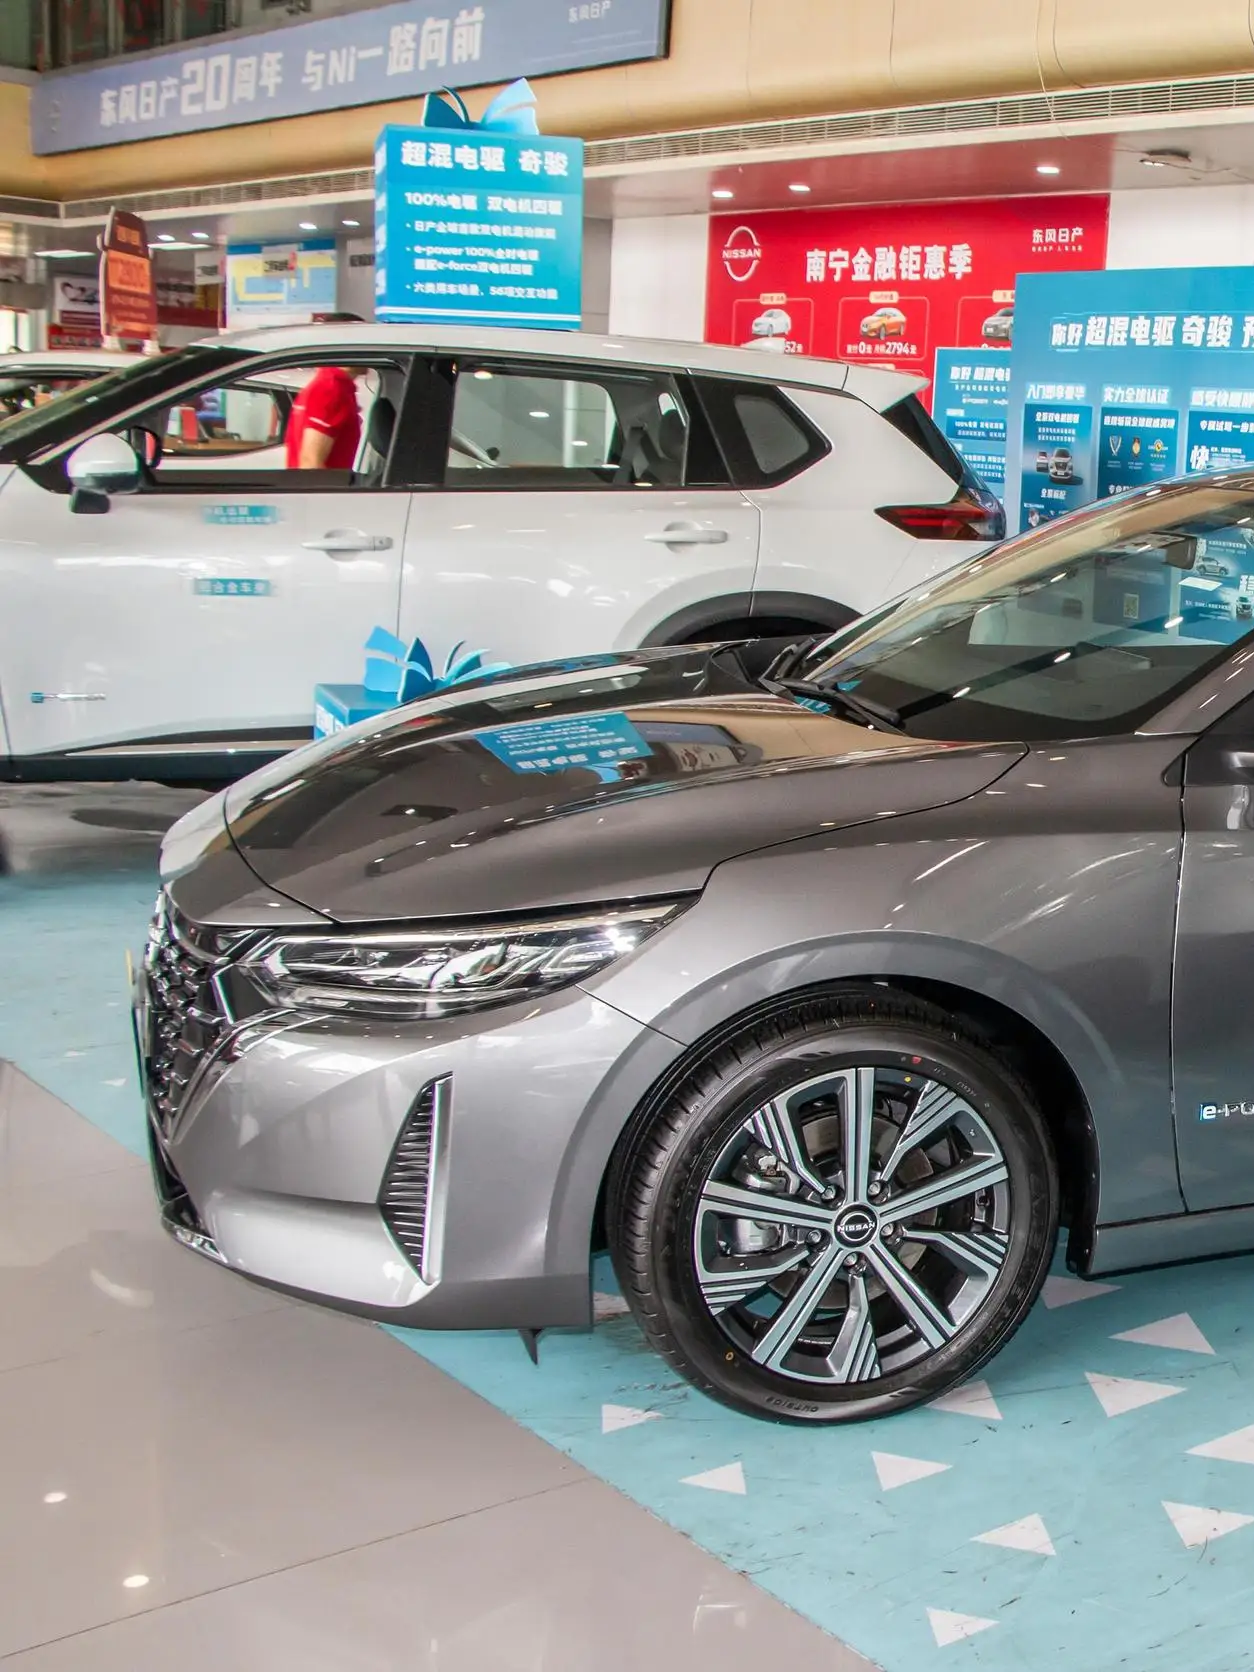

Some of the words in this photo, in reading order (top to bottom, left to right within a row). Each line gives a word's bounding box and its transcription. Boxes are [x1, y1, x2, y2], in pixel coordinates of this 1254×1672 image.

[518, 149, 568, 177] 奇骏
[1031, 226, 1084, 245] 东风日产
[722, 247, 762, 261] NISSAN
[805, 243, 974, 283] 南宁金融钜惠季
[1051, 323, 1083, 347] 你好
[1085, 315, 1176, 347] 超混电驱
[1181, 316, 1232, 348] 奇骏
[836, 1221, 876, 1234] NISSAN
